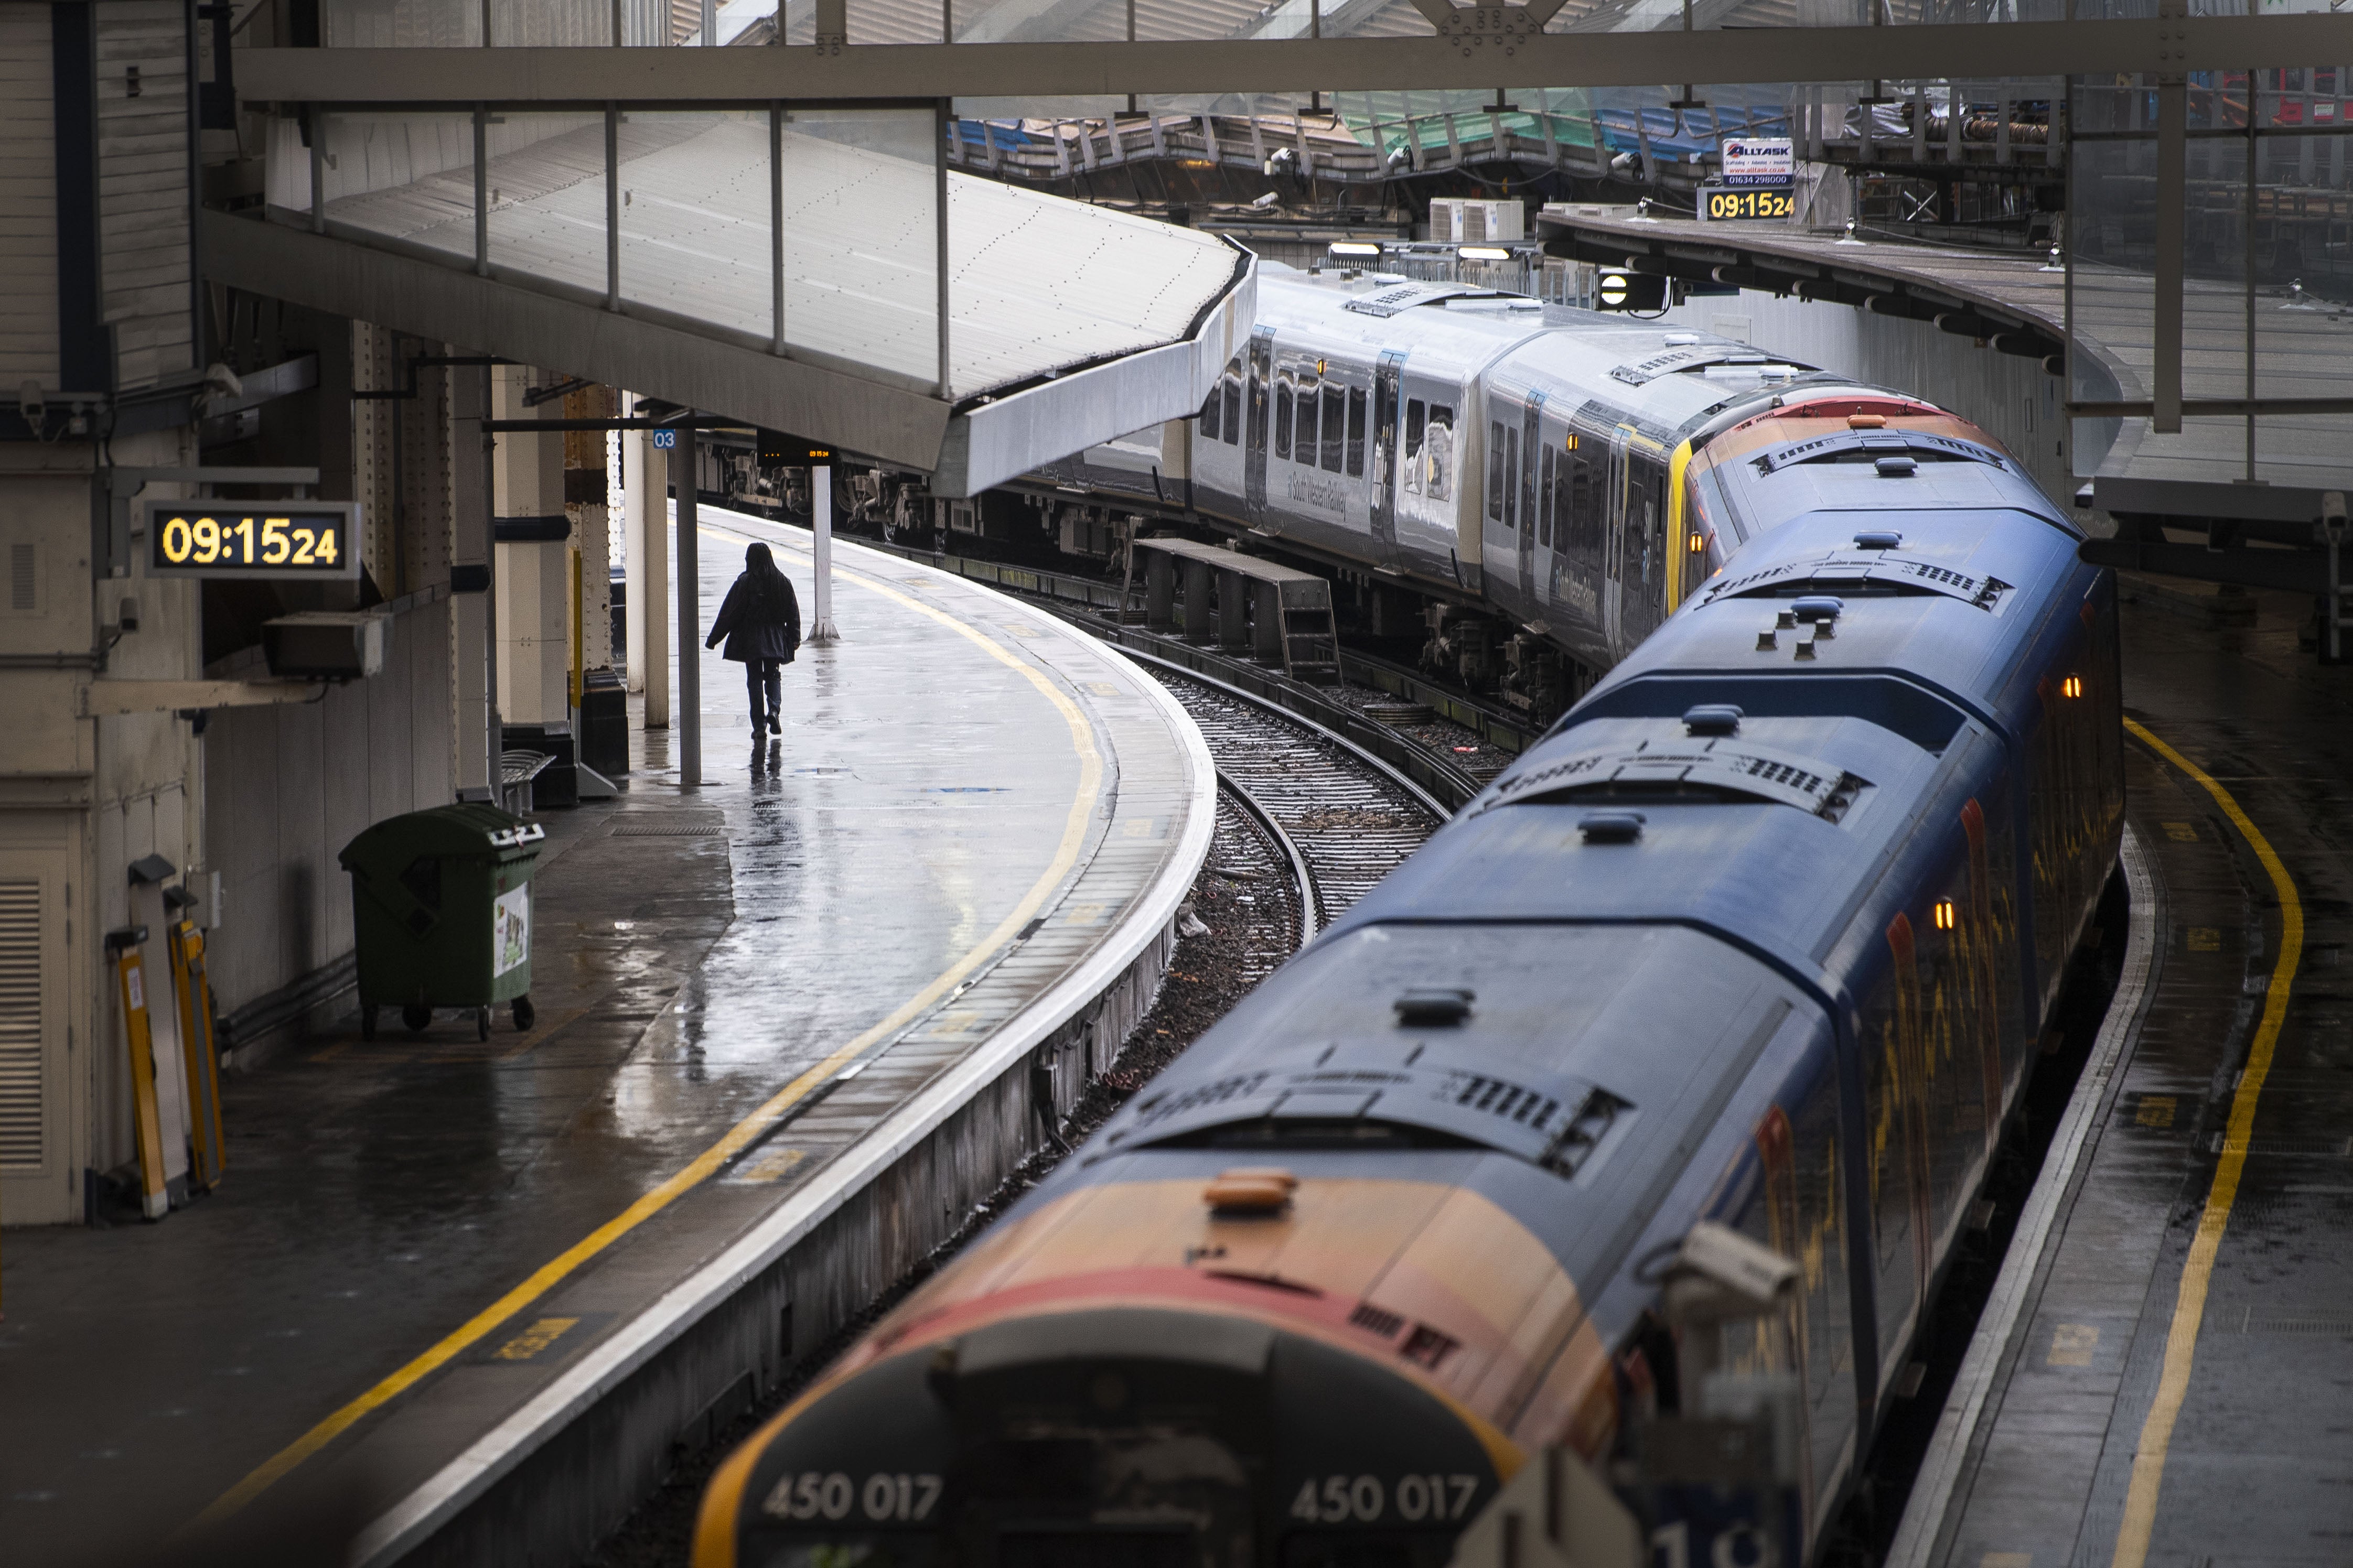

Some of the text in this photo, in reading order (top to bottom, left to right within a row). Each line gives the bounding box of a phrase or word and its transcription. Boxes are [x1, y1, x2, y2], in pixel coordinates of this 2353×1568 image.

[1729, 176, 1787, 184] 01634 298000
[654, 432, 674, 448] 03
[762, 1473, 944, 1520] 450 017
[1291, 1473, 1480, 1522] 450 017
